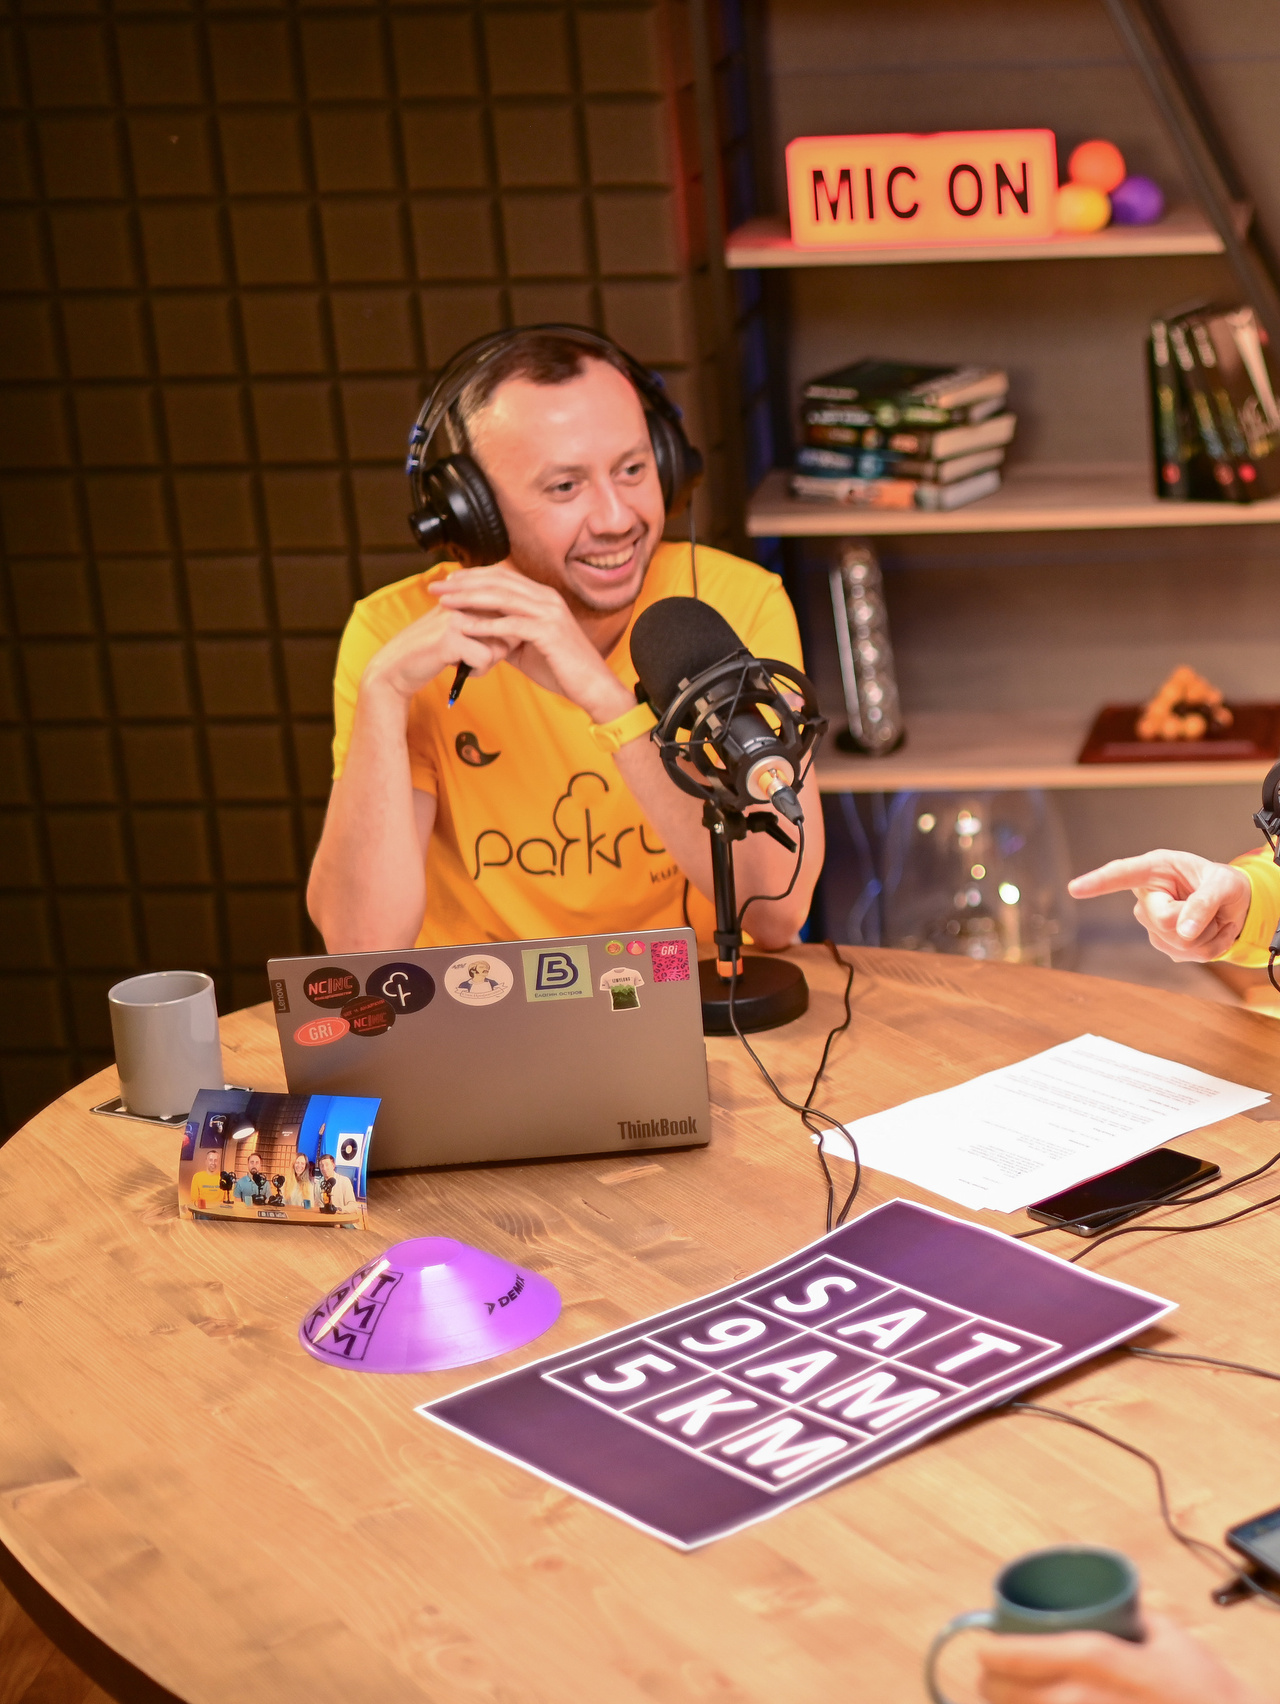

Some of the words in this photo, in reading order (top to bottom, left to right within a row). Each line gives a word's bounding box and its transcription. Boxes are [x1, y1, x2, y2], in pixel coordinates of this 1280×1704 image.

[811, 165, 920, 222] MIC
[948, 161, 1030, 217] ON
[472, 778, 667, 881] parkru
[661, 945, 678, 956] GRi
[275, 982, 287, 1011] Lenovo
[308, 1023, 333, 1041] GRi
[617, 1116, 698, 1140] ThinkBook
[497, 1273, 525, 1308] DEMIX
[772, 1275, 1022, 1374] SAT
[680, 1316, 942, 1431] 9AM
[583, 1352, 849, 1480] 5KM
